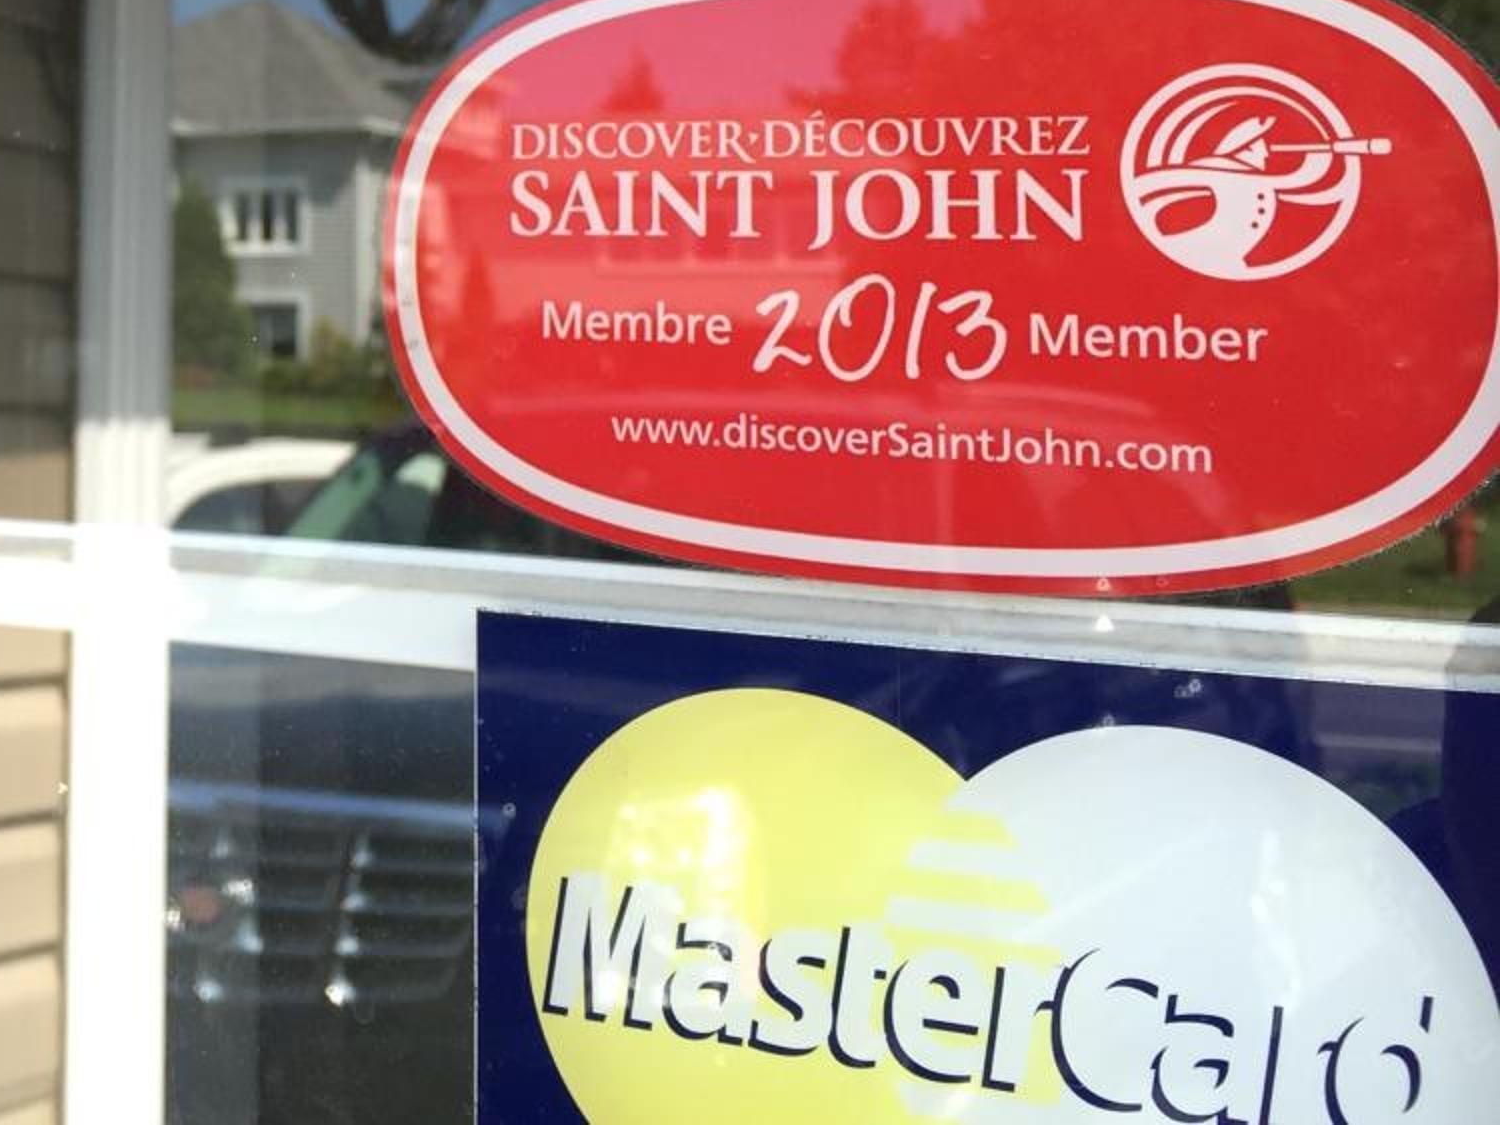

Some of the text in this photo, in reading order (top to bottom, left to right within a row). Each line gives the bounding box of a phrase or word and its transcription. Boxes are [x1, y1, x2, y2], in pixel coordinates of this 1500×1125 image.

[509, 169, 1088, 251] SAINT JOHN
[541, 273, 1268, 382] Membre 2013 Member
[611, 412, 1213, 475] www.discoverSaintJohn.com
[542, 875, 1435, 1125] MasterCard
